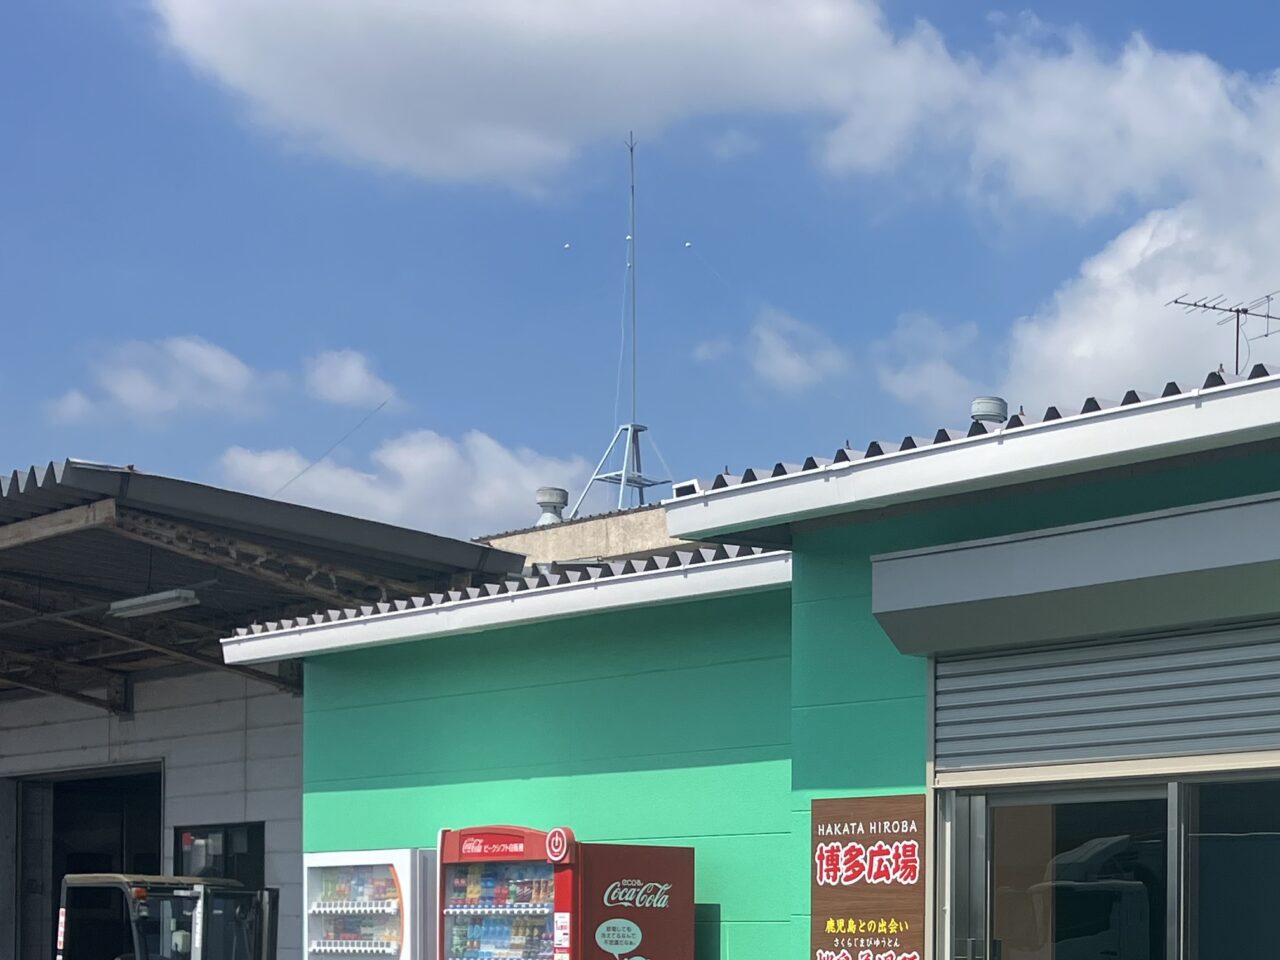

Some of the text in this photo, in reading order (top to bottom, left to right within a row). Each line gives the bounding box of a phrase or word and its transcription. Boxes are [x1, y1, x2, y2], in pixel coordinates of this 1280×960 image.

[818, 820, 918, 836] HAKATA HIROBA
[815, 840, 920, 885] 博多広場
[825, 918, 909, 934] 鹿児島との出会い
